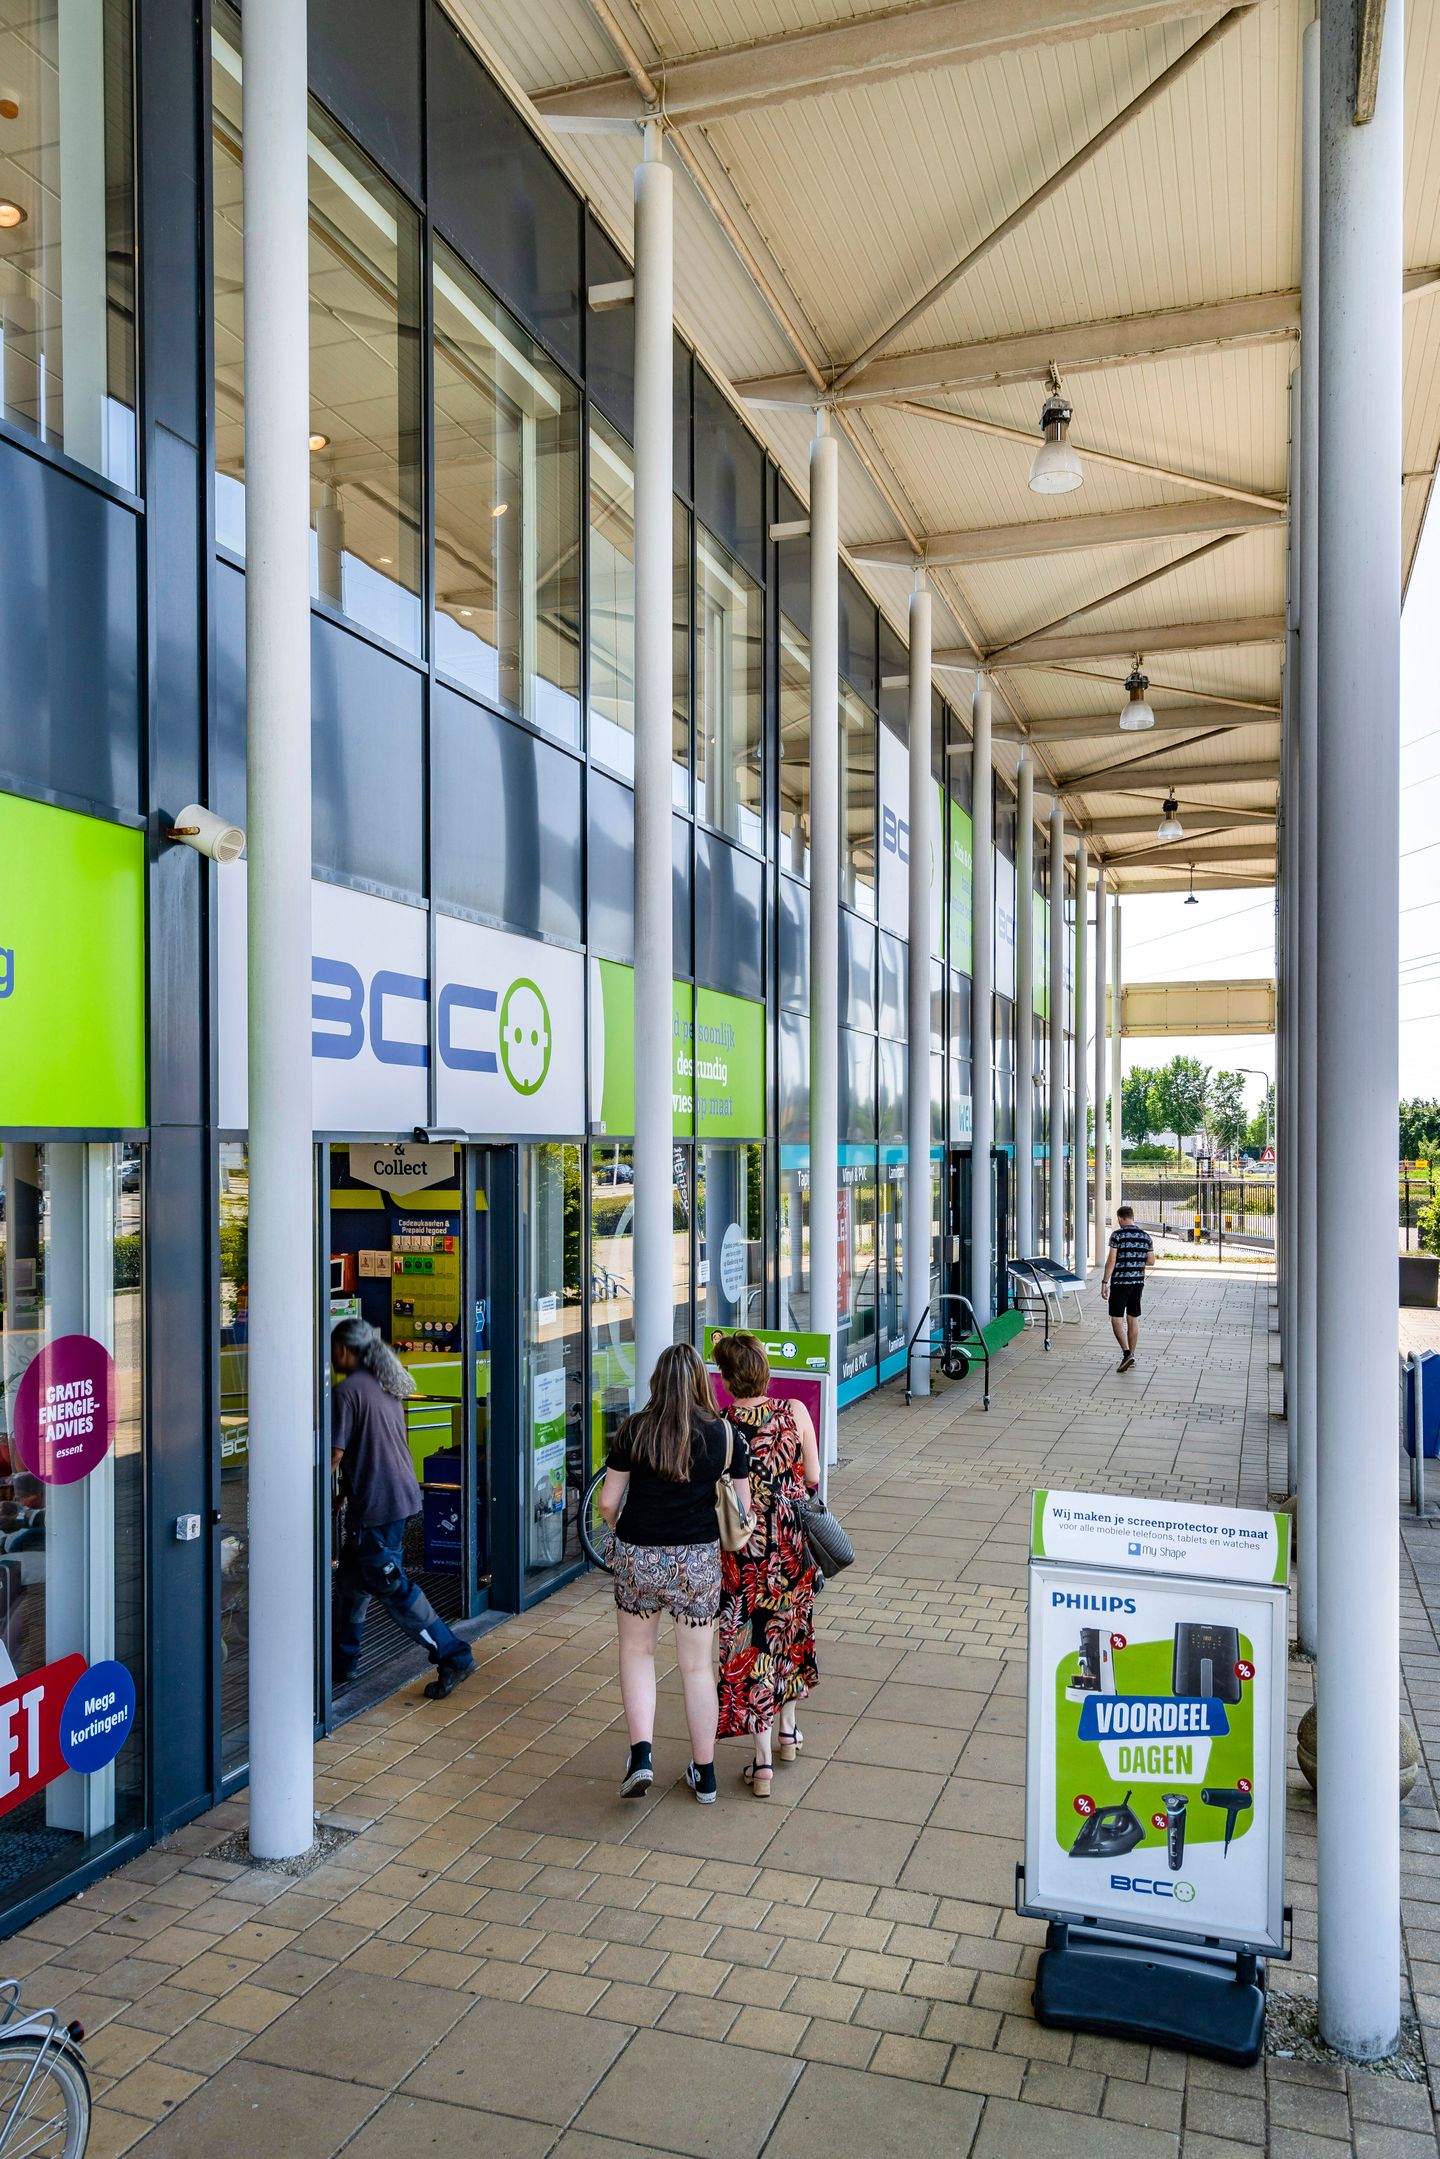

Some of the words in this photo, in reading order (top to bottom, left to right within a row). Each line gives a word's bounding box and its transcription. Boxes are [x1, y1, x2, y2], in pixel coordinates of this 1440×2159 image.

[883, 804, 909, 865] BC
[312, 956, 498, 1073] BCC
[682, 1021, 736, 1053] pesoonlijk
[677, 1050, 728, 1087] desundig
[709, 1096, 733, 1116] maat
[373, 1160, 428, 1176] Collect
[798, 1170, 810, 1189] Tapi
[398, 1219, 444, 1227] Cadeaukaarten
[444, 1220, 450, 1228] &
[401, 1227, 425, 1235] Prepaid
[425, 1227, 448, 1236] tegoed
[46, 1379, 93, 1403] GRATIS
[39, 1397, 100, 1425] ENERGIE-
[45, 1416, 94, 1442] ADVIES
[56, 1443, 84, 1459] essent
[1052, 1508, 1071, 1521] Wij
[1073, 1510, 1112, 1524] maken
[1114, 1513, 1125, 1526] je
[1127, 1517, 1218, 1535] screenprotector
[1221, 1527, 1236, 1539] op
[1239, 1528, 1269, 1540] maat
[1059, 1523, 1078, 1532] voor
[1079, 1523, 1095, 1533] alle
[1096, 1525, 1131, 1537] mobiele
[1132, 1528, 1175, 1542] telefoons,
[1177, 1533, 1207, 1545] tablets
[1209, 1537, 1221, 1546] en
[1222, 1537, 1261, 1551] watches
[1159, 1546, 1187, 1560] Shape
[1052, 1591, 1137, 1614] PHILIPS
[84, 1691, 116, 1717] Mega
[70, 1704, 129, 1747] kortingen!
[1096, 1702, 1211, 1734] VOORDEEL
[1118, 1744, 1193, 1775] DAGEN
[1110, 1874, 1174, 1897] BCC
